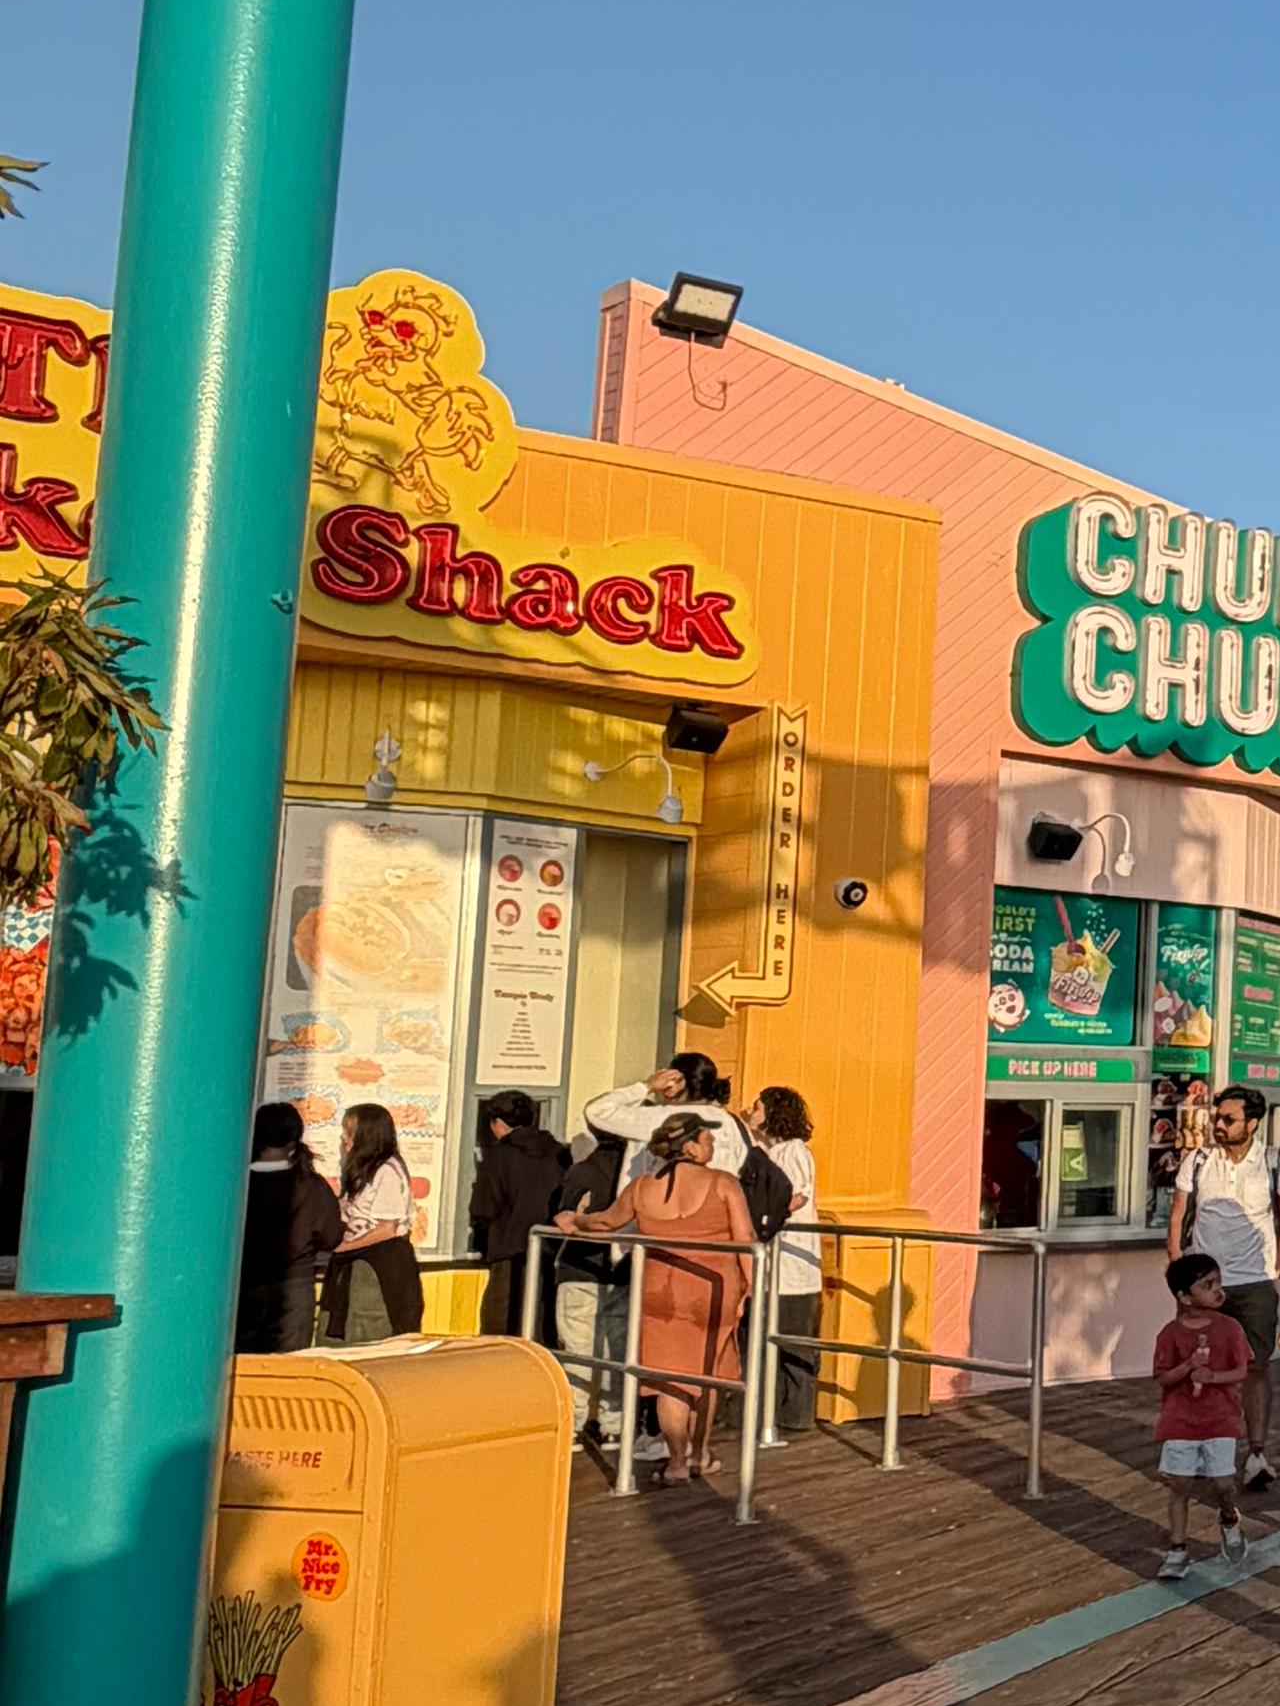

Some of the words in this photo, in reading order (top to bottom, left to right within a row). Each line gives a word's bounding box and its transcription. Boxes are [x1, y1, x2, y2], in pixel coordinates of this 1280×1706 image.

[311, 504, 745, 660] Shack
[780, 731, 799, 849] ORDER
[995, 904, 1036, 917] ORLD'S
[772, 883, 790, 976] HERE
[994, 915, 1036, 933] IRST
[989, 943, 1034, 960] ODA
[991, 959, 1034, 973] REAM
[1007, 1059, 1040, 1075] PICK
[1043, 1060, 1061, 1075] UP
[277, 1450, 323, 1469] HERE
[305, 1539, 339, 1557] Mr.
[301, 1557, 341, 1575] Nice
[302, 1574, 337, 1595] Fry
